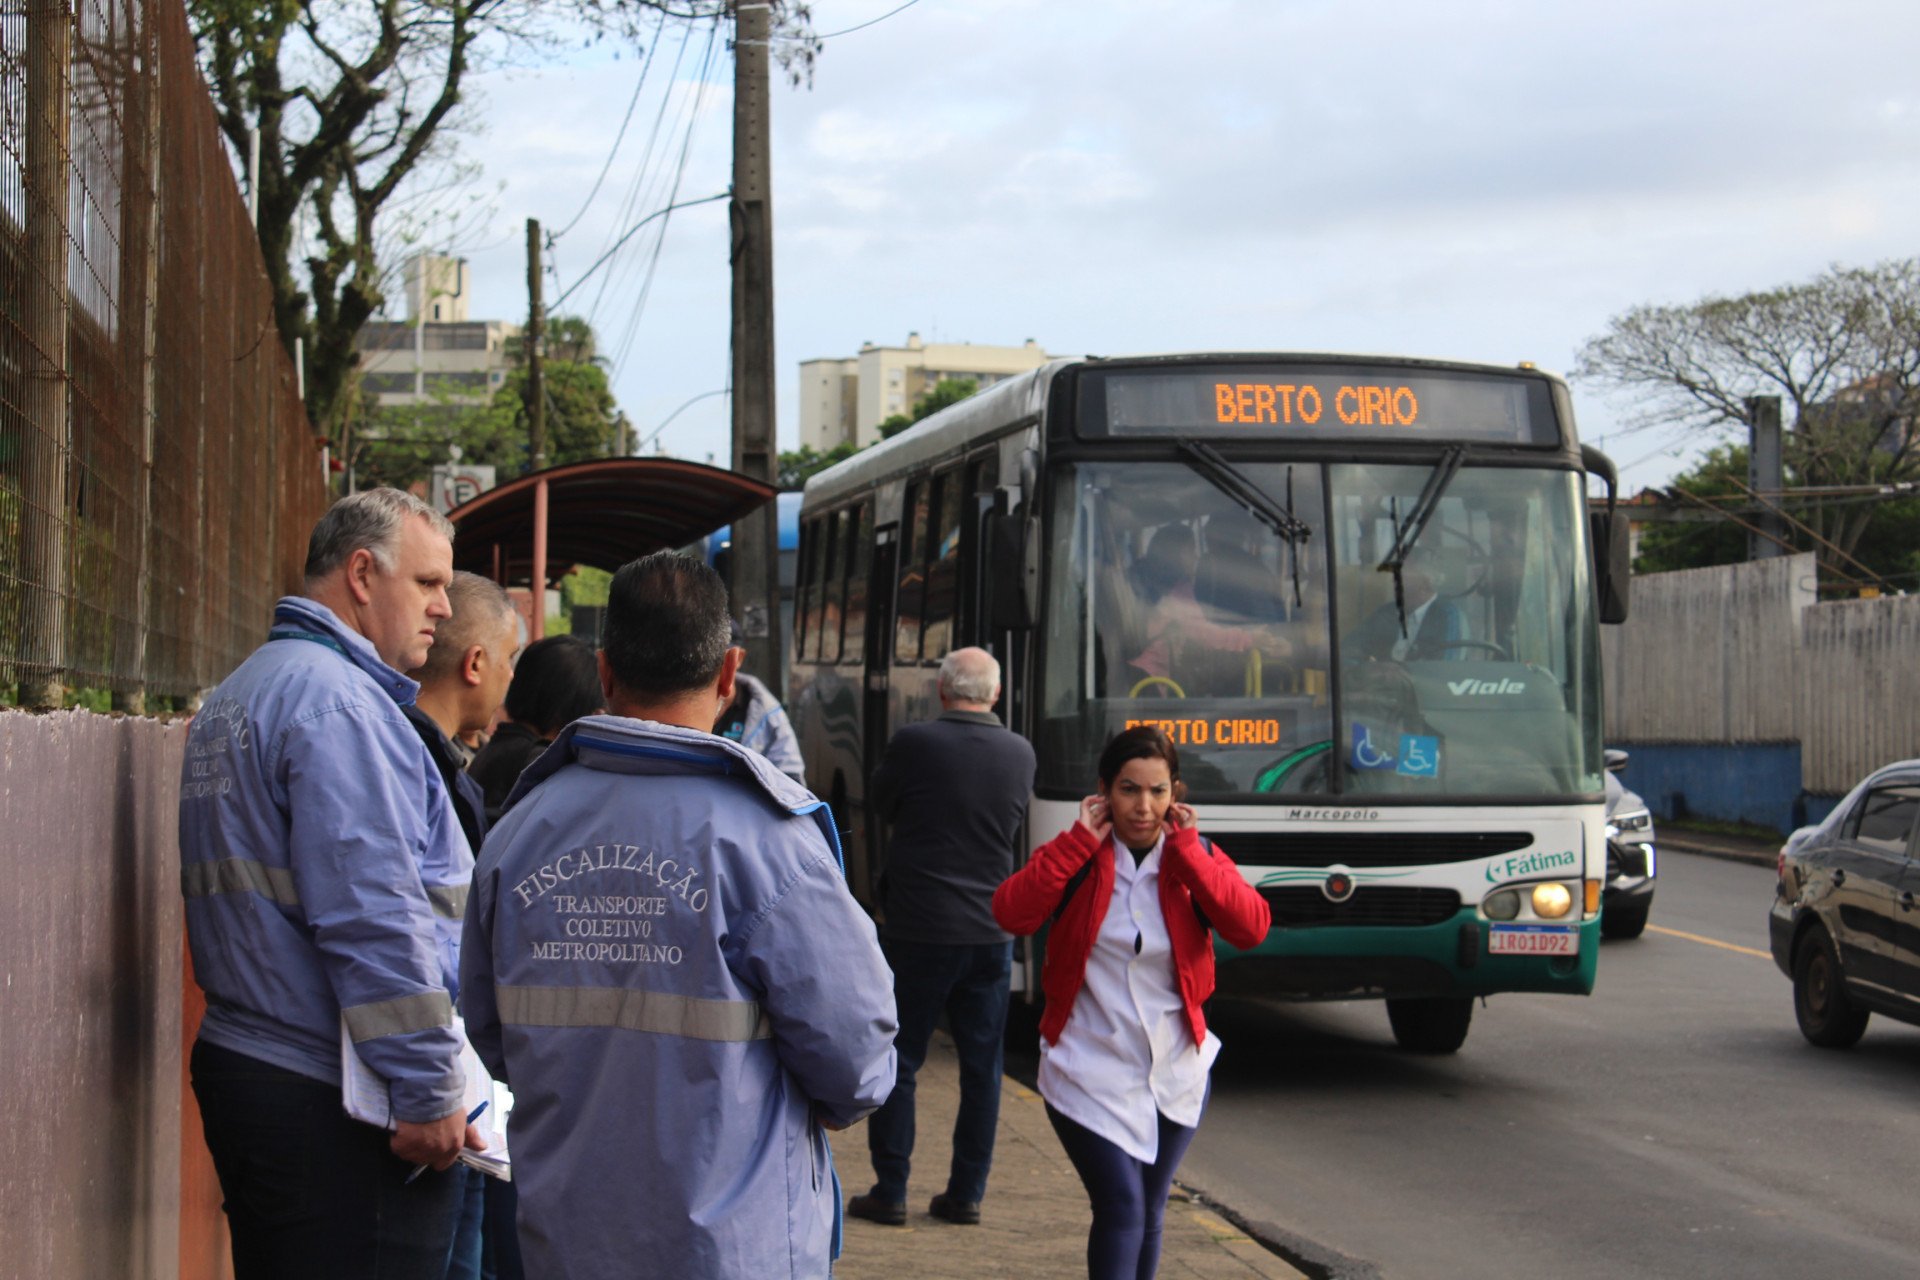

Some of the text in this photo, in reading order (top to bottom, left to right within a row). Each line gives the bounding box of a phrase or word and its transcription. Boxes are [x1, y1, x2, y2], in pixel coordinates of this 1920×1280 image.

[1215, 384, 1418, 425] BERTO CIRIO
[1447, 678, 1525, 696] Viale
[1125, 719, 1279, 745] RTO CIRIO
[1289, 809, 1378, 821] Marcopolo
[1505, 850, 1575, 877] Fátima
[513, 844, 708, 912] FISCALIZAÇÃO
[553, 895, 666, 915] TRANSPORTE
[566, 918, 651, 938] COLETIVO
[532, 942, 683, 965] METROPOLITANO
